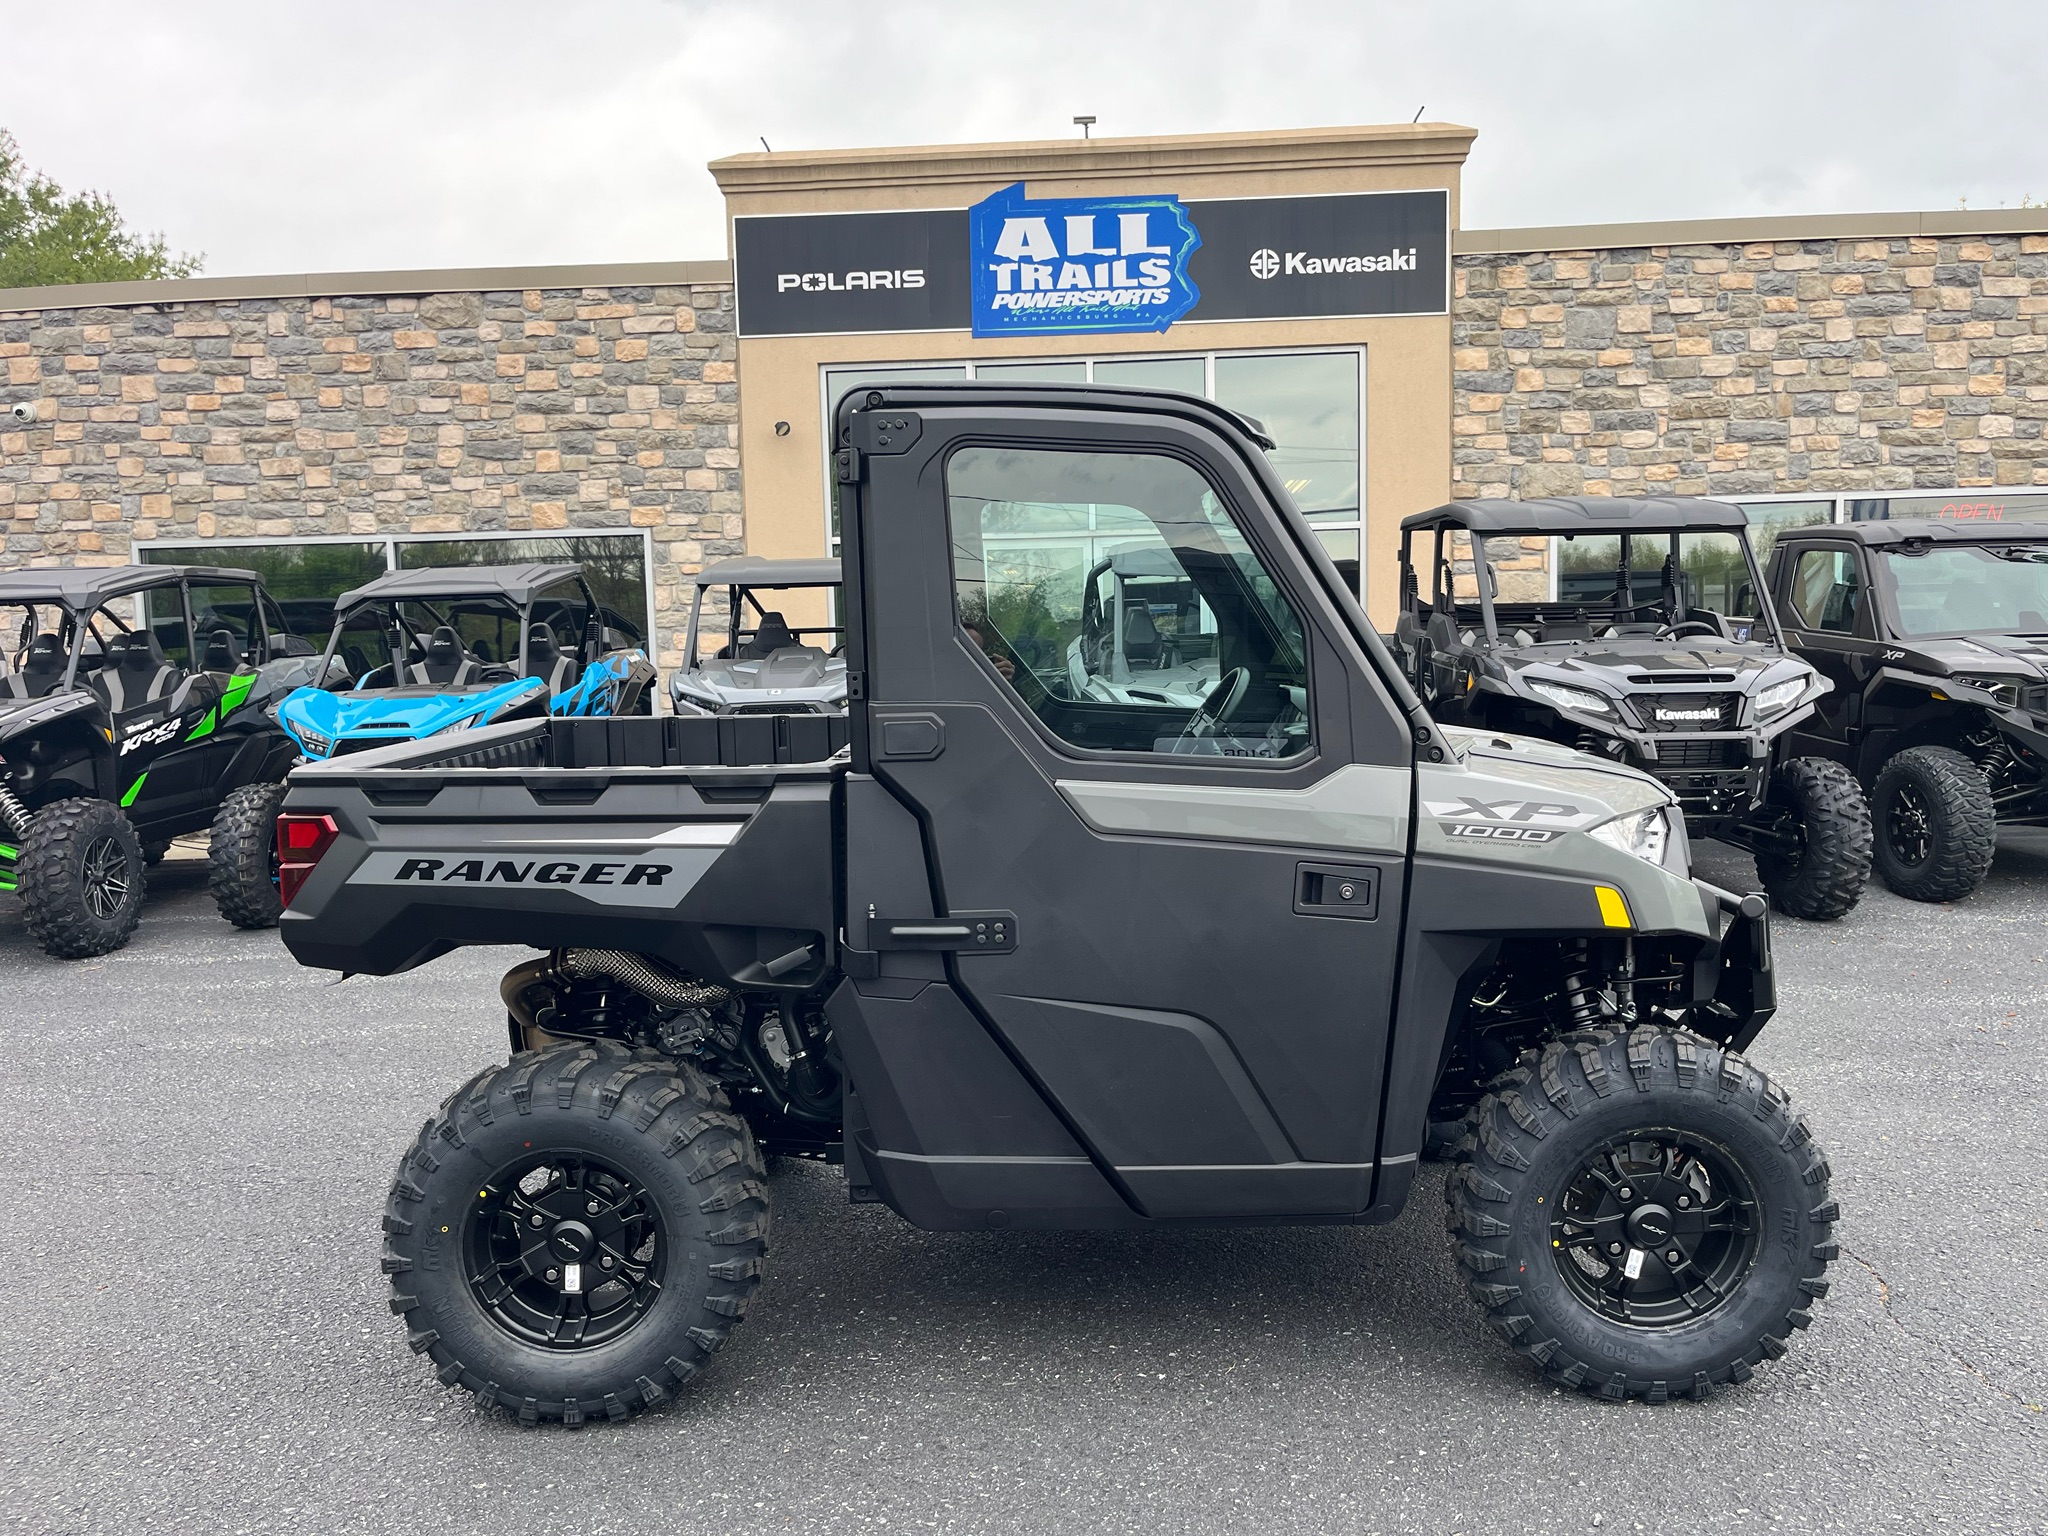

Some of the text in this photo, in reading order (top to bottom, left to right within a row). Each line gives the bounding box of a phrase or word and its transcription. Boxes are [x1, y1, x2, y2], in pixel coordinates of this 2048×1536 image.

[993, 212, 1171, 262] ALL
[1284, 247, 1417, 275] Kawasaki
[777, 269, 926, 293] POLARIS
[989, 257, 1172, 291] TRAILS
[991, 287, 1170, 310] POWERSPORTS
[1939, 503, 2005, 522] OPEN
[1881, 649, 1906, 661] XP
[1655, 707, 1720, 721] Kawasaki
[154, 730, 177, 745] 1000
[1437, 796, 1581, 822] XP
[1445, 837, 1542, 850] DUAL OVERHEAD CAM
[1451, 823, 1552, 842] 1000
[393, 858, 674, 886] RANGER
[1545, 1299, 1640, 1365] PRO ARMOR
